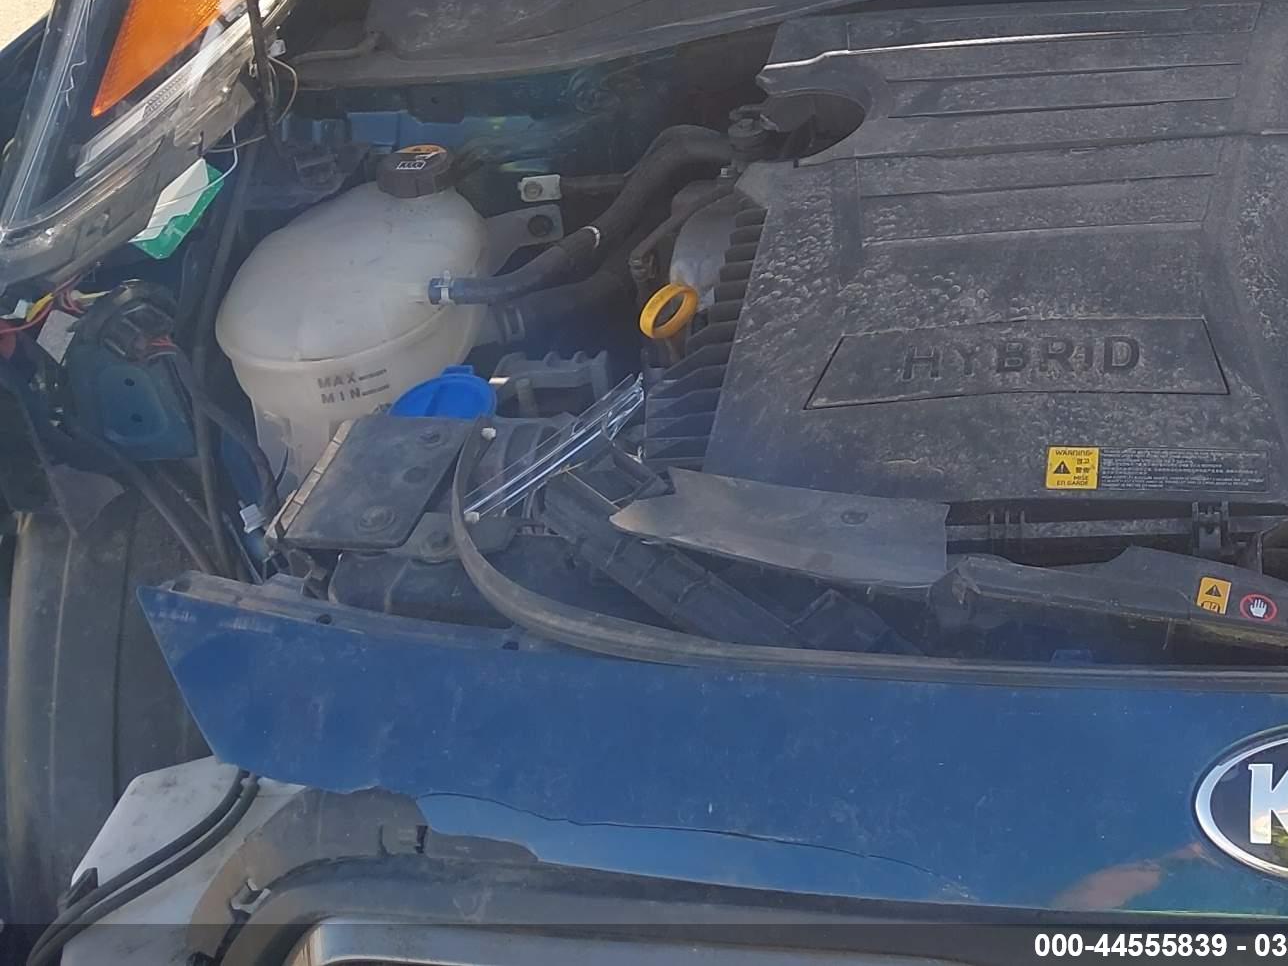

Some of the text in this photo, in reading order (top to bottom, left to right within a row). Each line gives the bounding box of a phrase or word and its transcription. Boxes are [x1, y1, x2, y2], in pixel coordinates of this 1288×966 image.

[902, 335, 1141, 380] HYBRID
[317, 370, 357, 389] MAX
[321, 387, 361, 404] MIN
